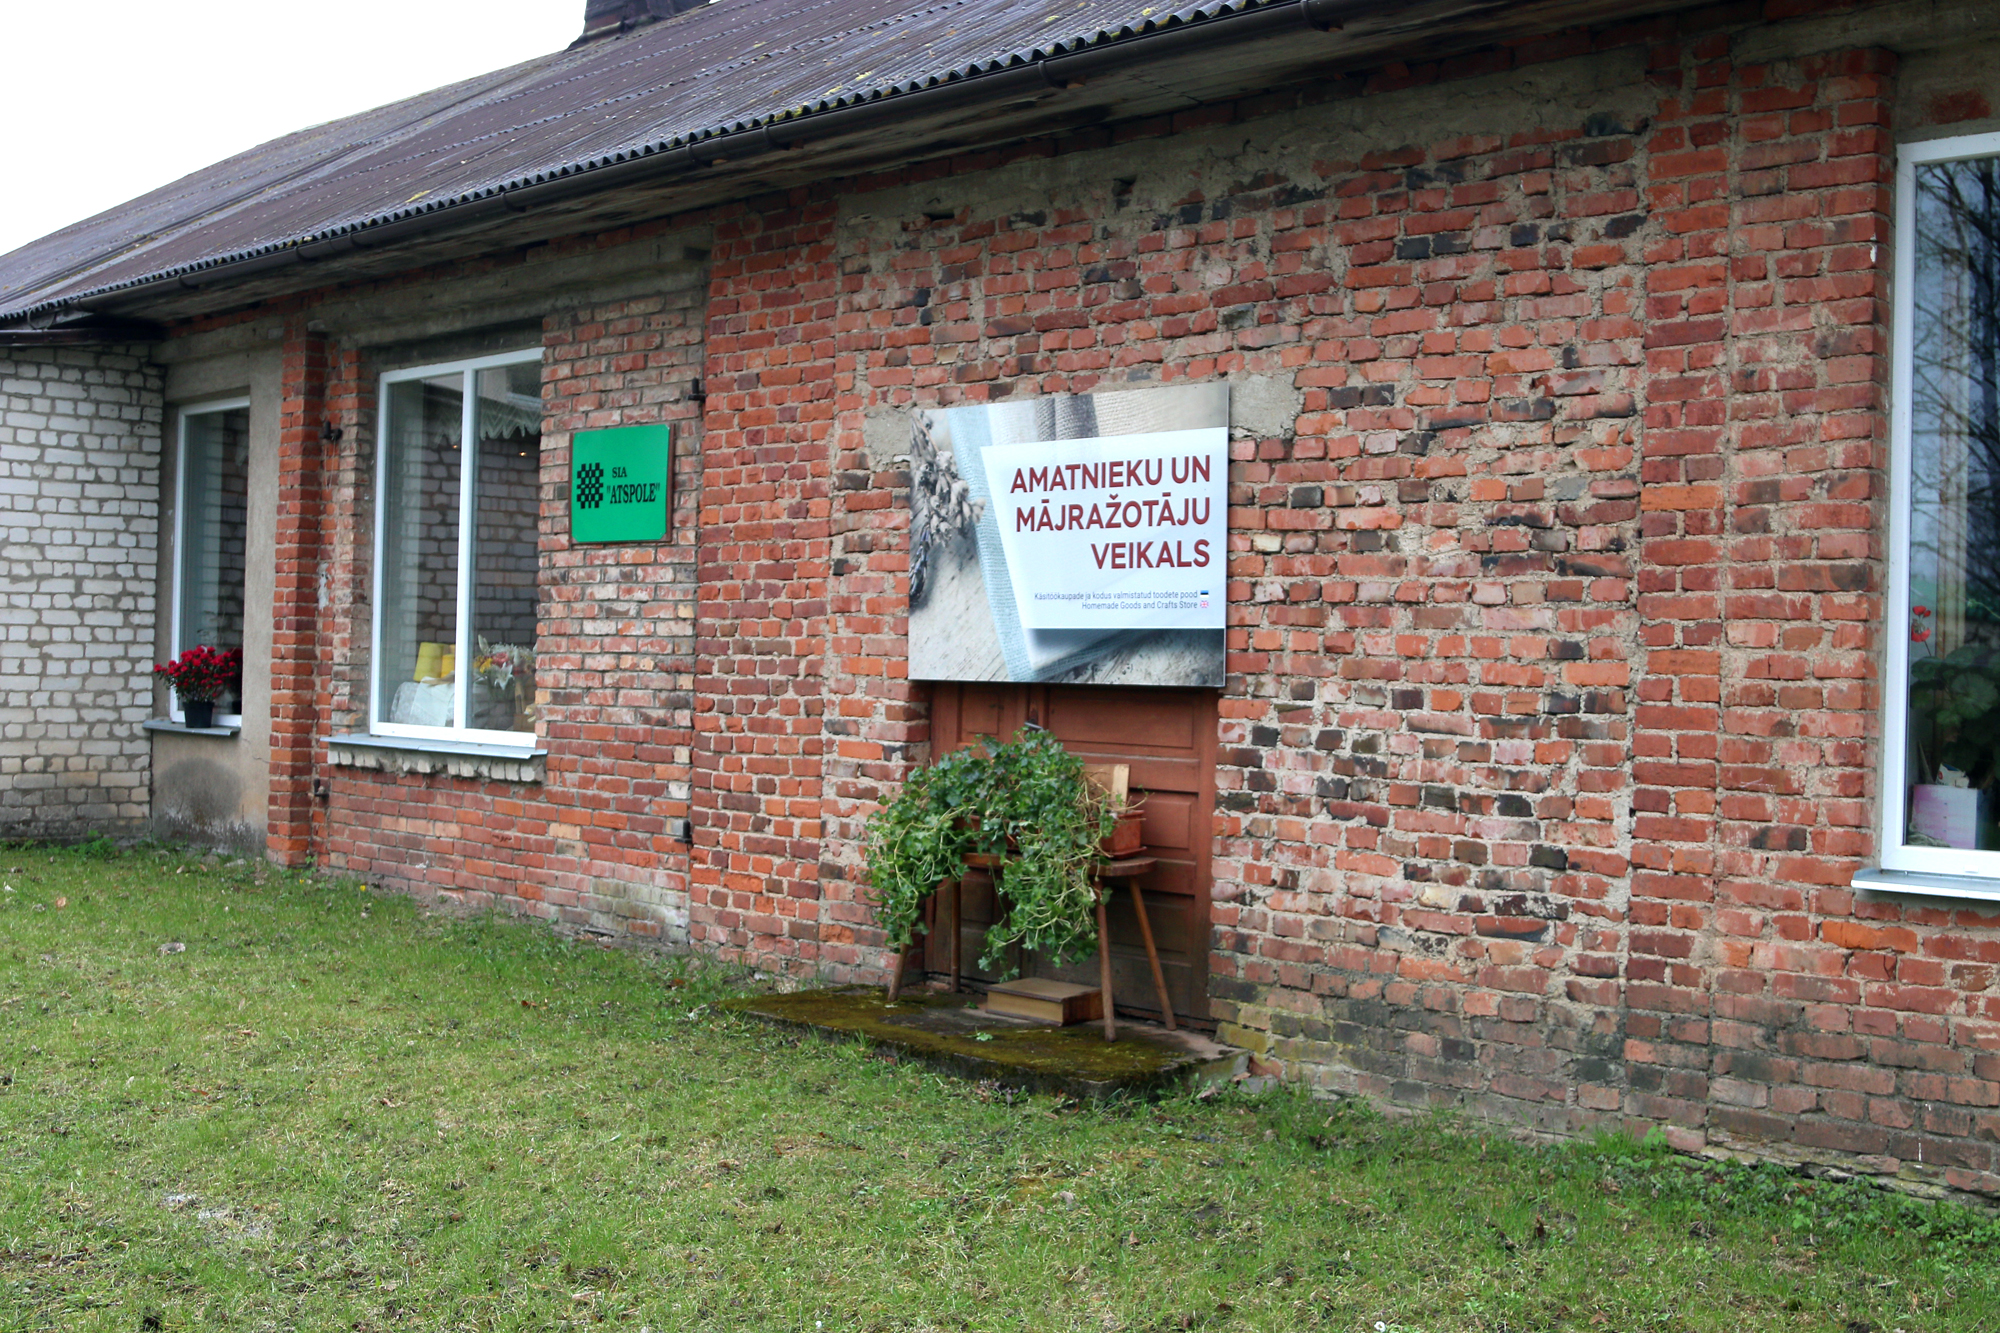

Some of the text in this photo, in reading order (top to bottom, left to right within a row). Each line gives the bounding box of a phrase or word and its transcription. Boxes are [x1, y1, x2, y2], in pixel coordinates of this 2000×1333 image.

[612, 467, 627, 478] SIA
[1010, 454, 1210, 494] AMATNIEKU UN
[606, 482, 660, 504] "ATSPOLE"
[1016, 492, 1210, 532] MĀJRAŽOTĀJU
[1091, 539, 1210, 569] VEIKALS
[1034, 590, 1198, 601] Käsitöökaupade ja kodus valmistatud toodete pood
[1081, 601, 1198, 609] Homemade Goods and Crafts Store
